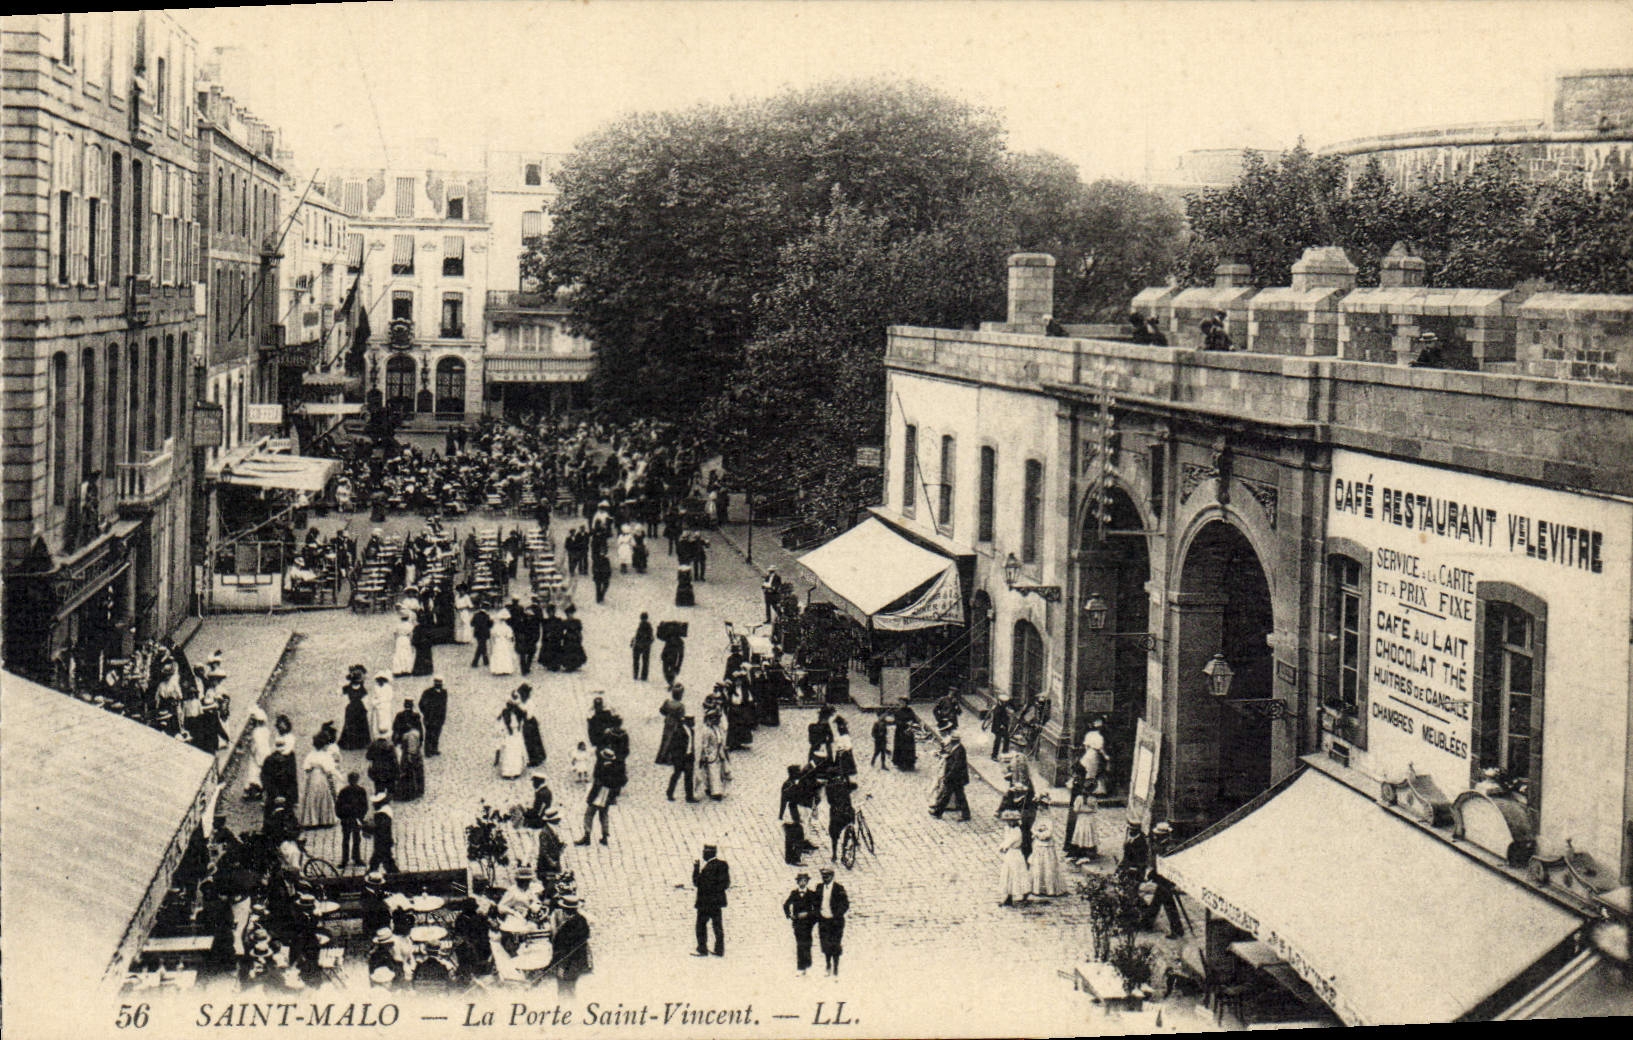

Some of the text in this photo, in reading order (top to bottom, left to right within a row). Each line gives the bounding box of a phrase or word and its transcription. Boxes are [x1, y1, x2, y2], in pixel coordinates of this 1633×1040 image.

[1335, 473, 1374, 519] CAFÉ
[1382, 487, 1497, 547] RESTAURANT
[1377, 547, 1420, 579] SERVICE
[1439, 564, 1475, 595] CARTE
[1399, 580, 1428, 608] PRIX
[1439, 592, 1473, 622] FIXE
[1376, 609, 1469, 660] CAFÉ AU LAIT
[1375, 637, 1468, 693] CHOCOLAT THÉ
[1413, 685, 1424, 701] DE
[1425, 687, 1470, 721] CANCALE
[1372, 701, 1468, 760] CHAMBRES MEUBLÉES
